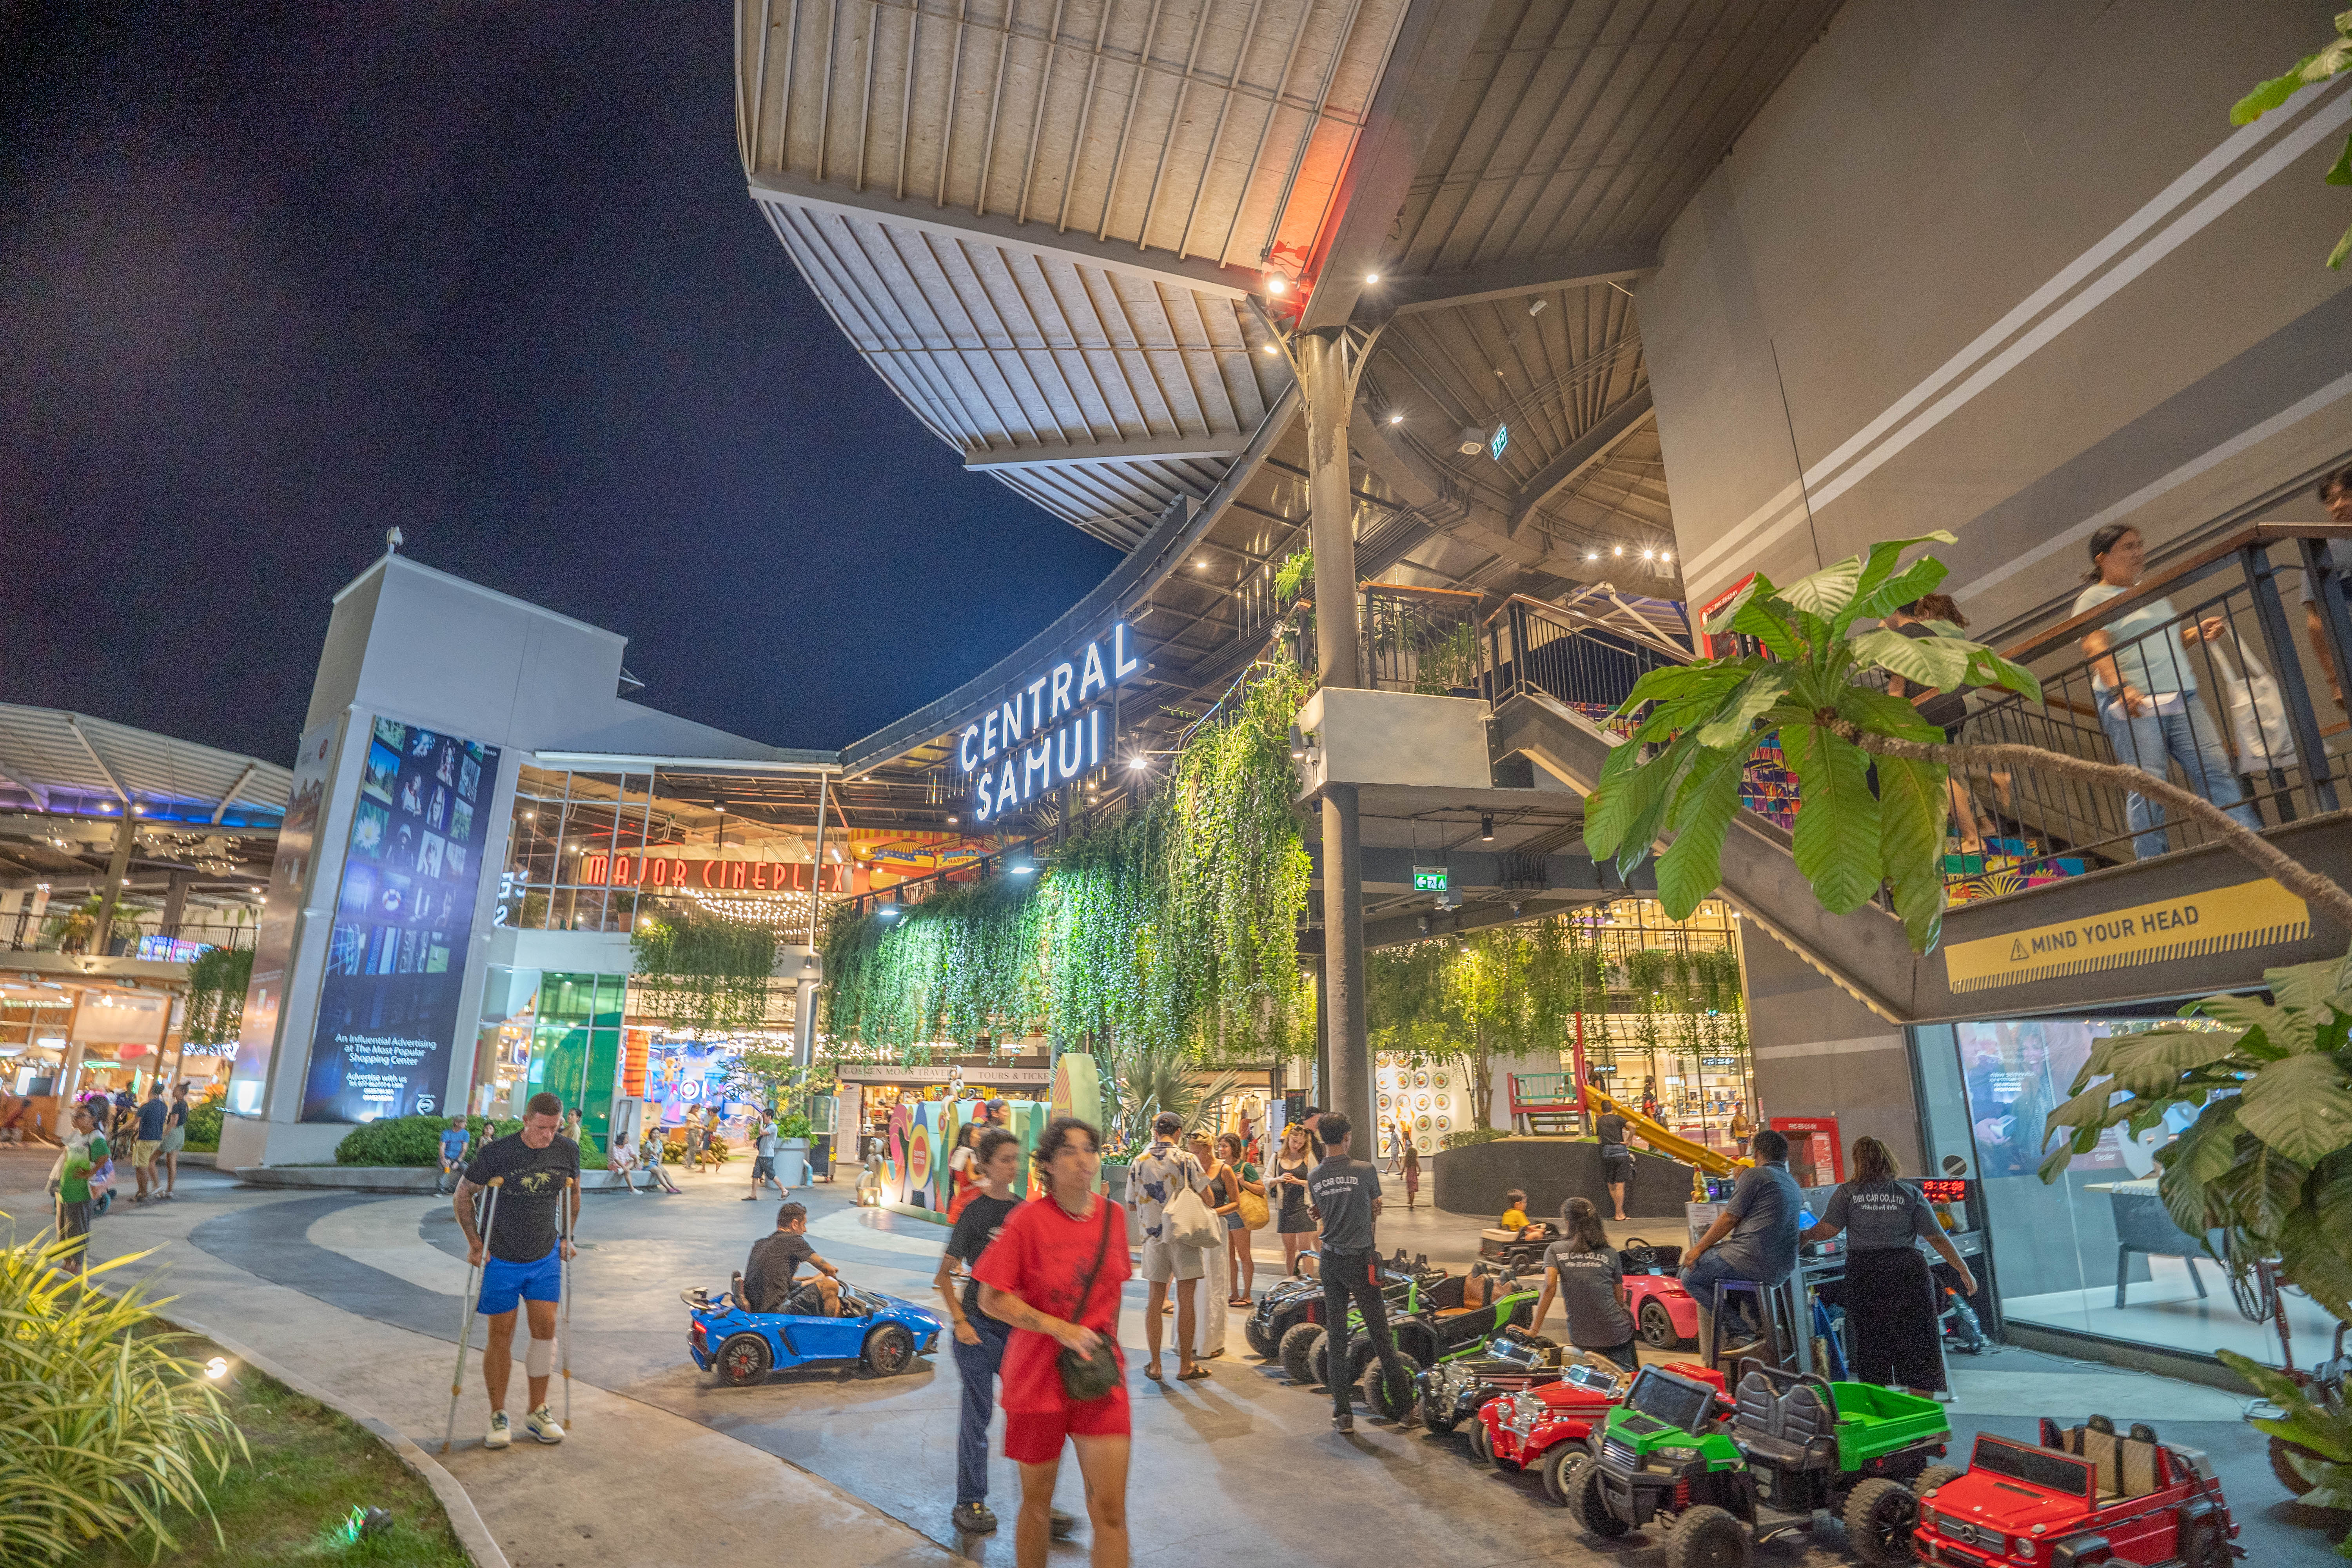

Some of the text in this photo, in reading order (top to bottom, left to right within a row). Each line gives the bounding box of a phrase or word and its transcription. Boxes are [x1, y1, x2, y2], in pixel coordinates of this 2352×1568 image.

[962, 623, 1136, 771] CENTRAL
[977, 710, 1098, 820] SAMUI
[587, 855, 687, 886] MAJOR
[2031, 906, 2199, 954] MIND YOUR HEAD
[335, 1033, 437, 1050] An Influential Advertising
[354, 1045, 372, 1054] The
[372, 1045, 393, 1055] Most
[394, 1047, 426, 1057] Popular
[348, 1053, 418, 1066] Shopping Center
[346, 1072, 381, 1082] Advertise
[381, 1074, 397, 1082] with
[844, 1067, 882, 1075] GOLDEN
[886, 1068, 915, 1076] MOON
[1322, 1178, 1335, 1187] CAR
[1853, 1194, 1865, 1203] BIBI
[1866, 1194, 1879, 1202] CAR
